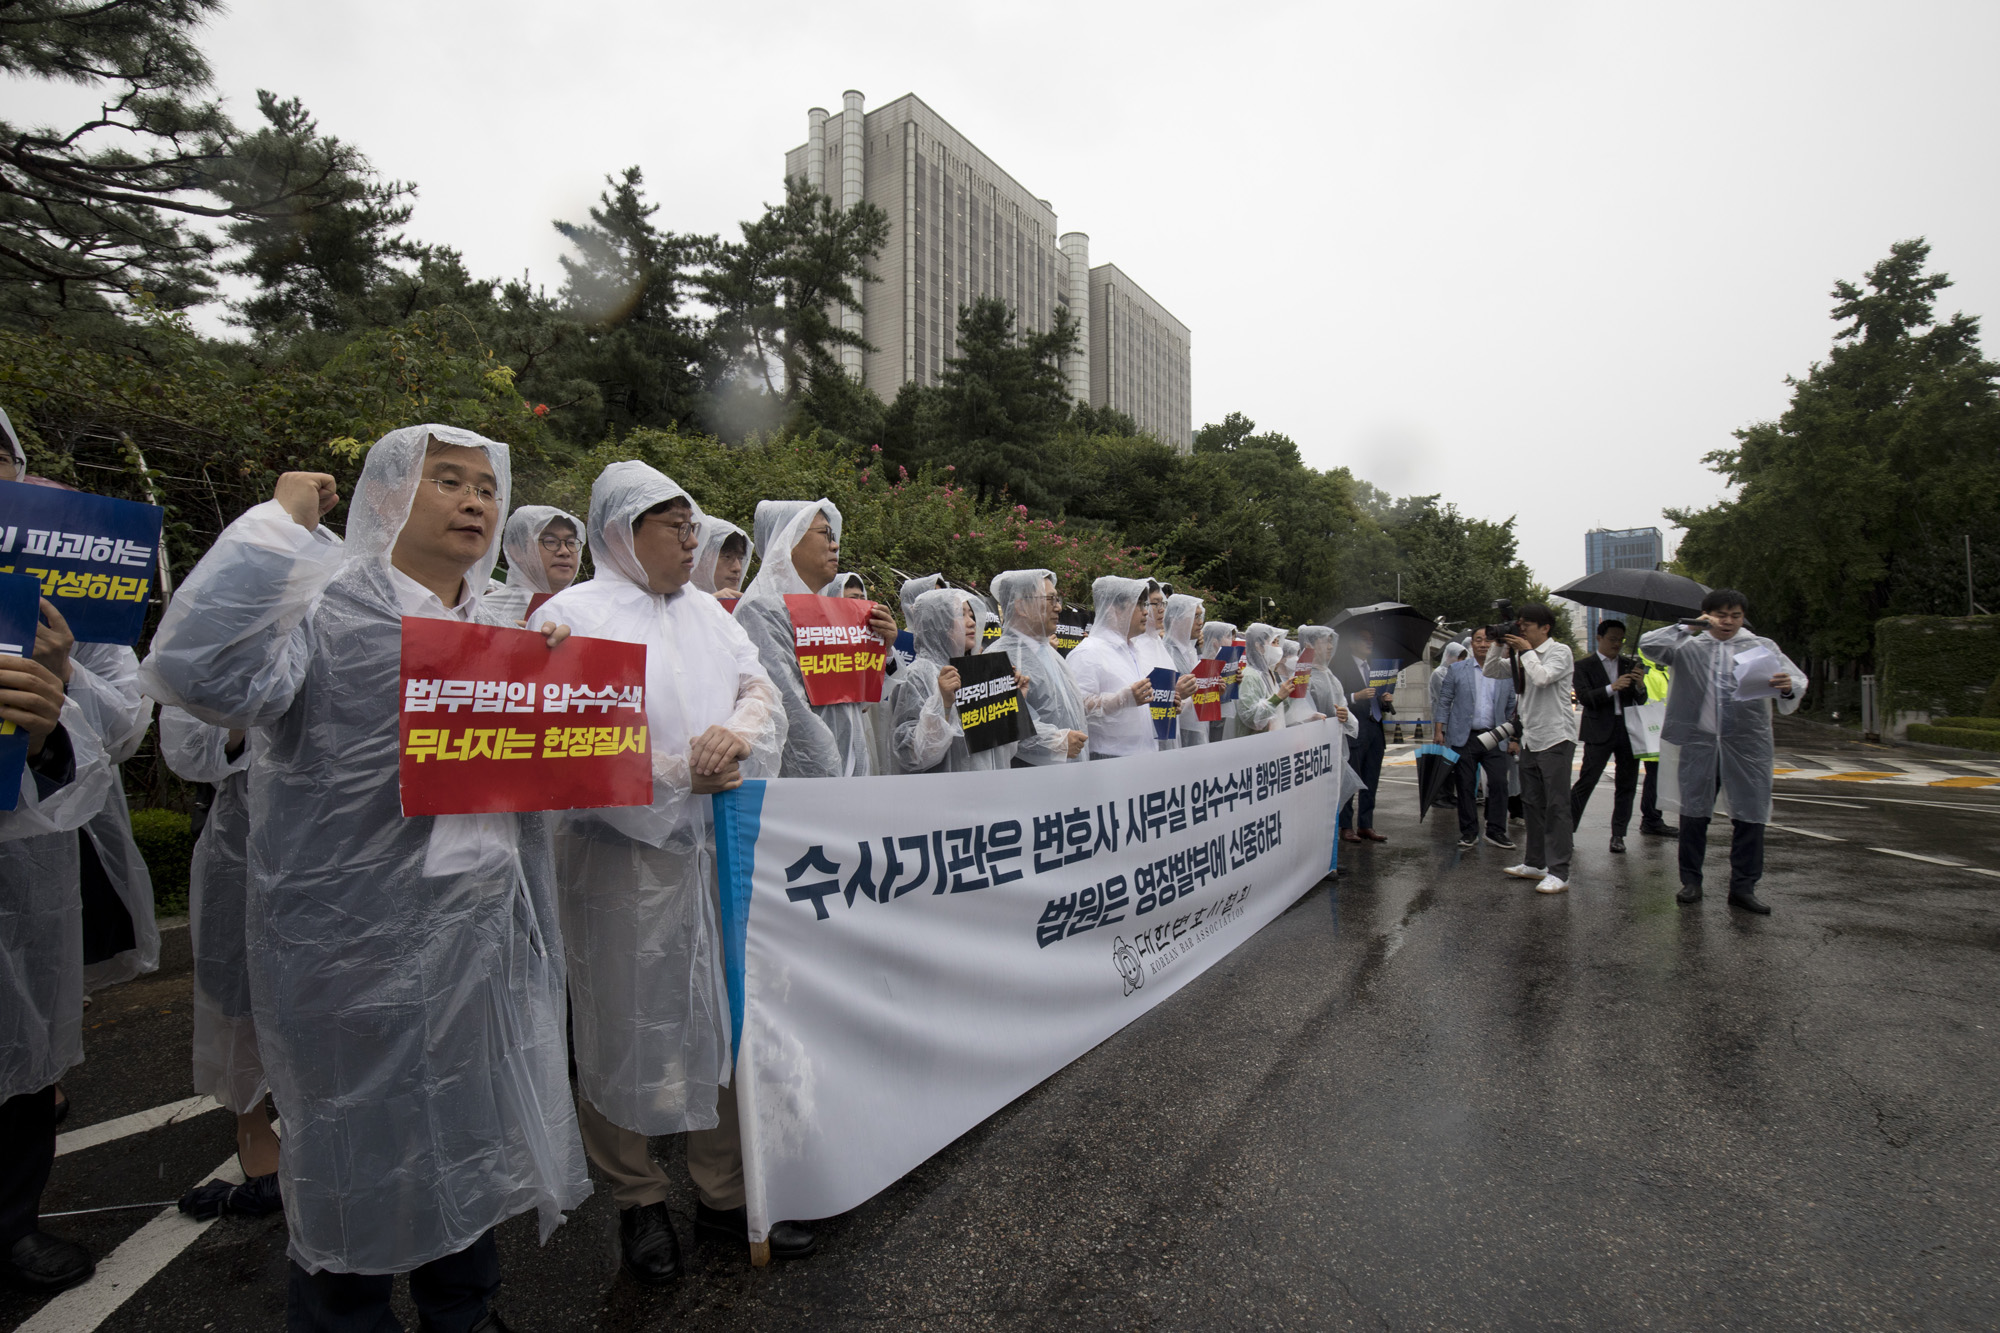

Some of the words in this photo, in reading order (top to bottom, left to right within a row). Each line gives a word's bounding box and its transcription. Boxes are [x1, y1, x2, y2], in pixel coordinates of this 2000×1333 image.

[21, 529, 152, 567] 파괴하는
[25, 568, 150, 602] 각성하라
[796, 626, 848, 647] 법무법인
[799, 653, 852, 676] 무너지는
[404, 679, 537, 713] 법무법인
[543, 683, 643, 714] 압수수색
[955, 681, 988, 707] 민주주의
[989, 675, 1017, 697] 파괴하는
[961, 706, 988, 730] 변호사
[988, 697, 1019, 721] 압수수색
[405, 728, 537, 763] 무너지는
[542, 726, 648, 759] 헌정질서
[785, 819, 1024, 921] 수사기관은
[1033, 801, 1120, 875] 변호사
[1126, 785, 1187, 847] 사무실
[1191, 767, 1253, 826] 압수수색
[1255, 755, 1292, 802] 행위를
[1293, 743, 1334, 788] 중단하고,
[1036, 874, 1130, 949] 법원은
[1134, 834, 1228, 916] 영장발부에
[1229, 810, 1283, 871] 신중하라
[1134, 884, 1252, 958] 대한변호사협회
[1149, 947, 1180, 975] KOREAN
[1180, 937, 1196, 955] BAR
[1196, 905, 1246, 944] ASSOCIATION
